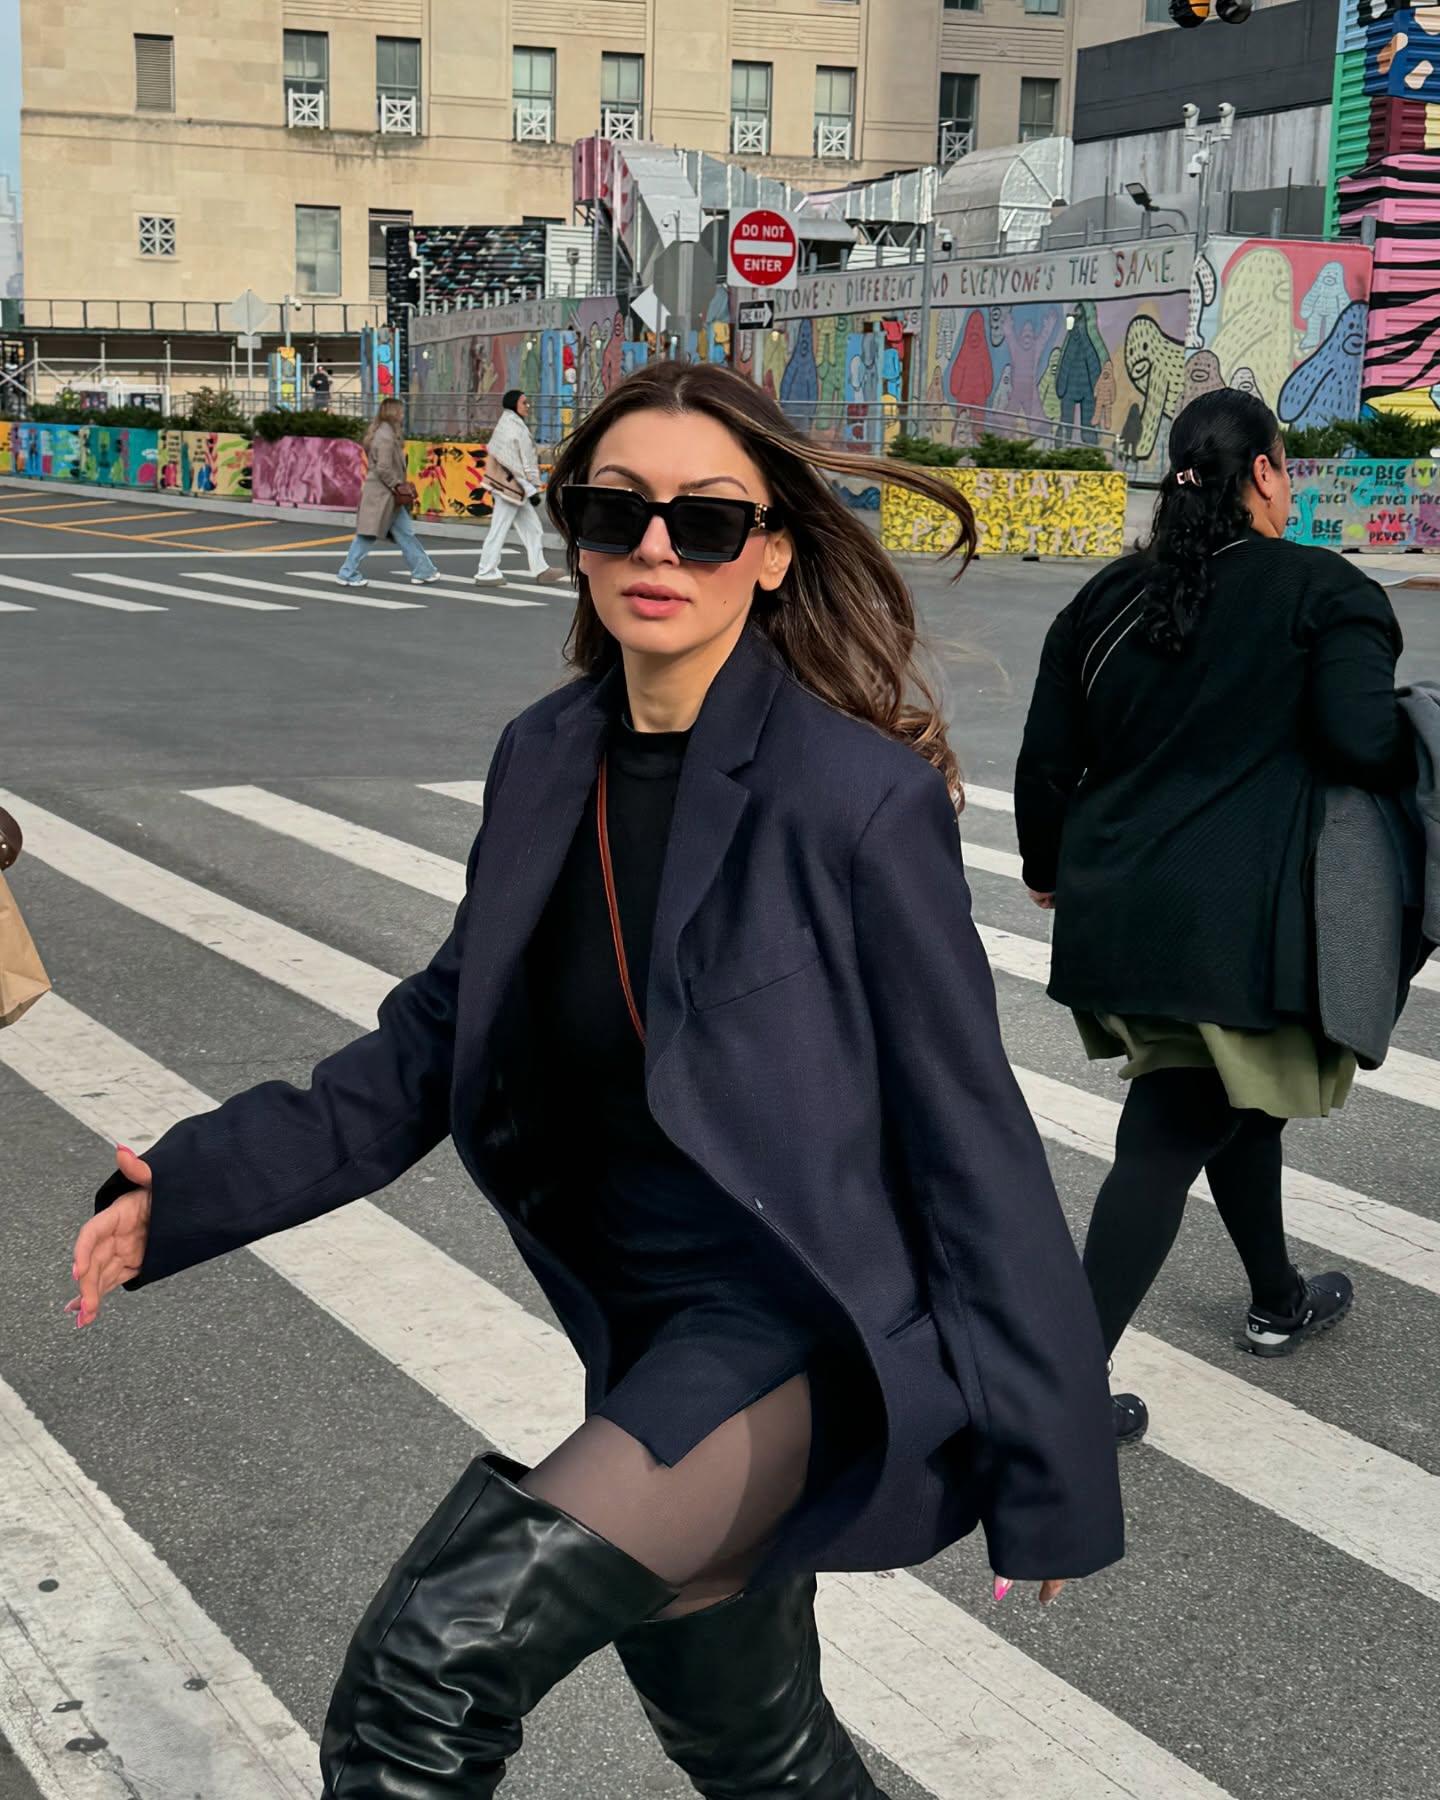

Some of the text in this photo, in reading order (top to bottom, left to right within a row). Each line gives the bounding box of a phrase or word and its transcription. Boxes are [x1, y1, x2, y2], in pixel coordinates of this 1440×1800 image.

[742, 224, 786, 238] DO NOT
[744, 258, 782, 272] ENTER
[846, 274, 915, 306] DIFFERENT
[921, 272, 949, 300] ND
[960, 263, 1054, 298] EVERYONE'S
[1069, 256, 1098, 286] THE
[754, 309, 767, 321] WAY
